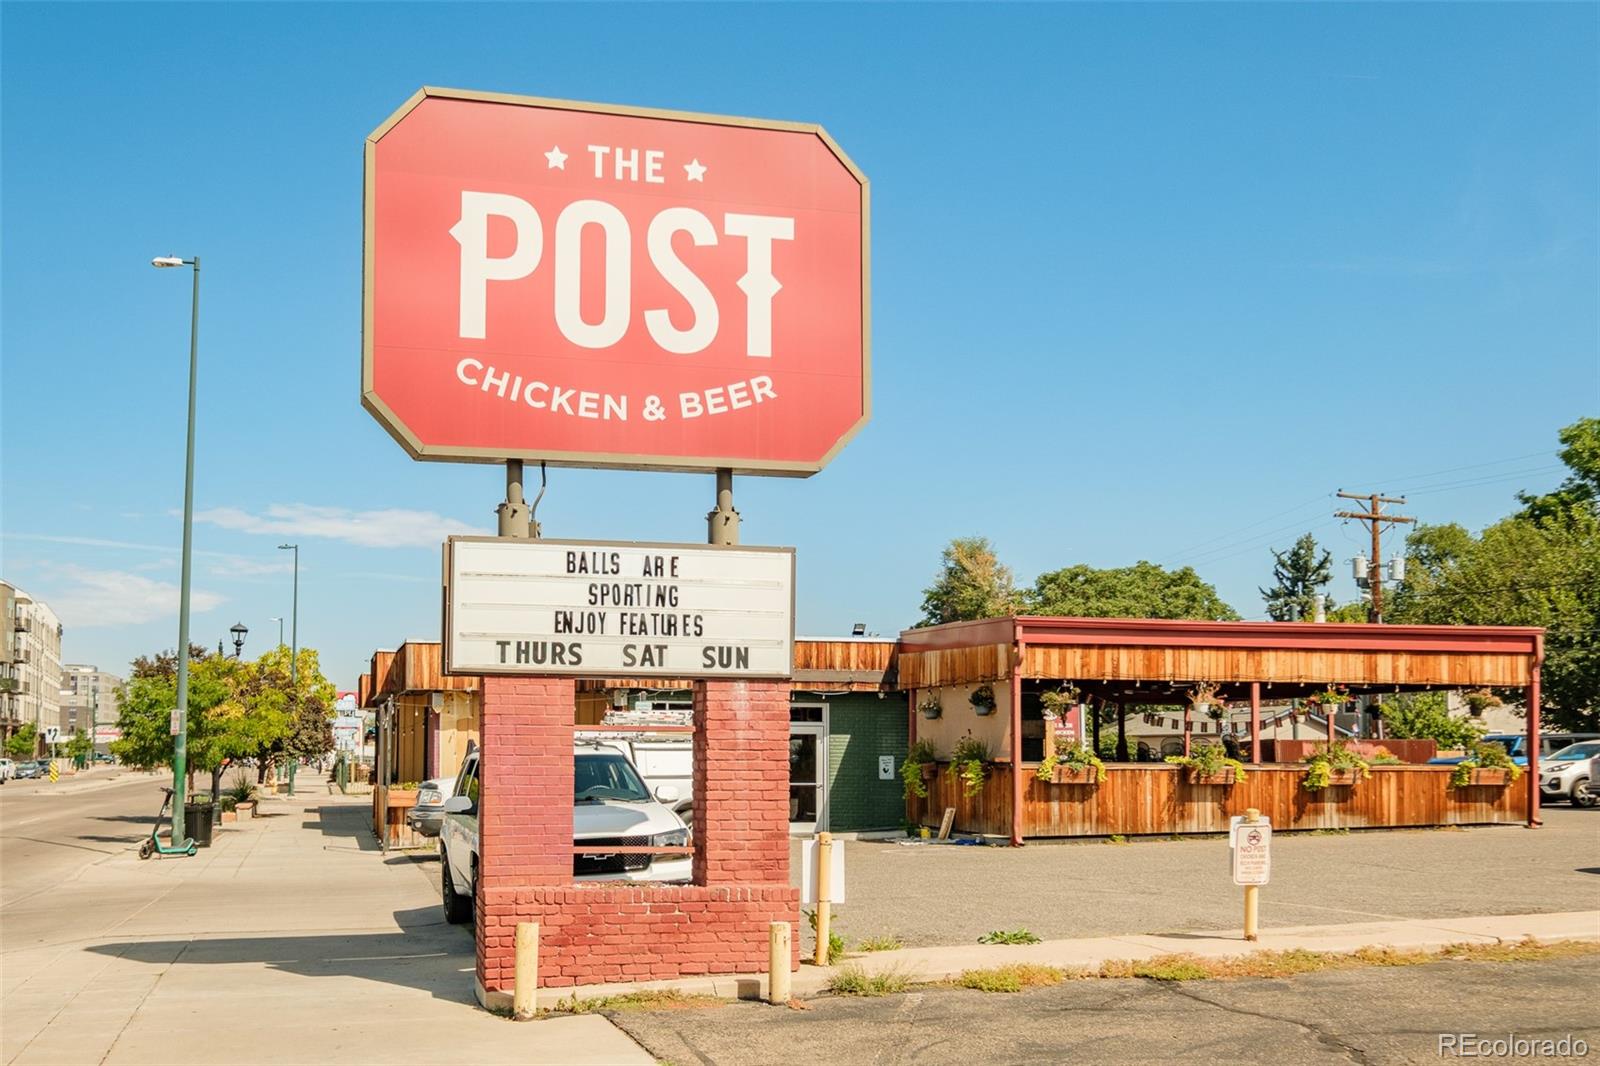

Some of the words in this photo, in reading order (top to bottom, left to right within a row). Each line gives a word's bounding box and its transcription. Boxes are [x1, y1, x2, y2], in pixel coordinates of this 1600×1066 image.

[588, 144, 664, 183] THE
[448, 190, 795, 358] POST
[456, 358, 627, 421] CHICKEN
[642, 395, 667, 421] &
[679, 375, 778, 419] BEER
[566, 551, 620, 575] BALLS
[643, 556, 679, 578] ARE
[588, 583, 679, 608] SPORTING
[554, 611, 606, 634] ENJOY
[620, 613, 704, 637] FEATURES
[496, 640, 583, 666] THURS
[622, 644, 668, 667] SAT
[702, 645, 749, 669] SUN
